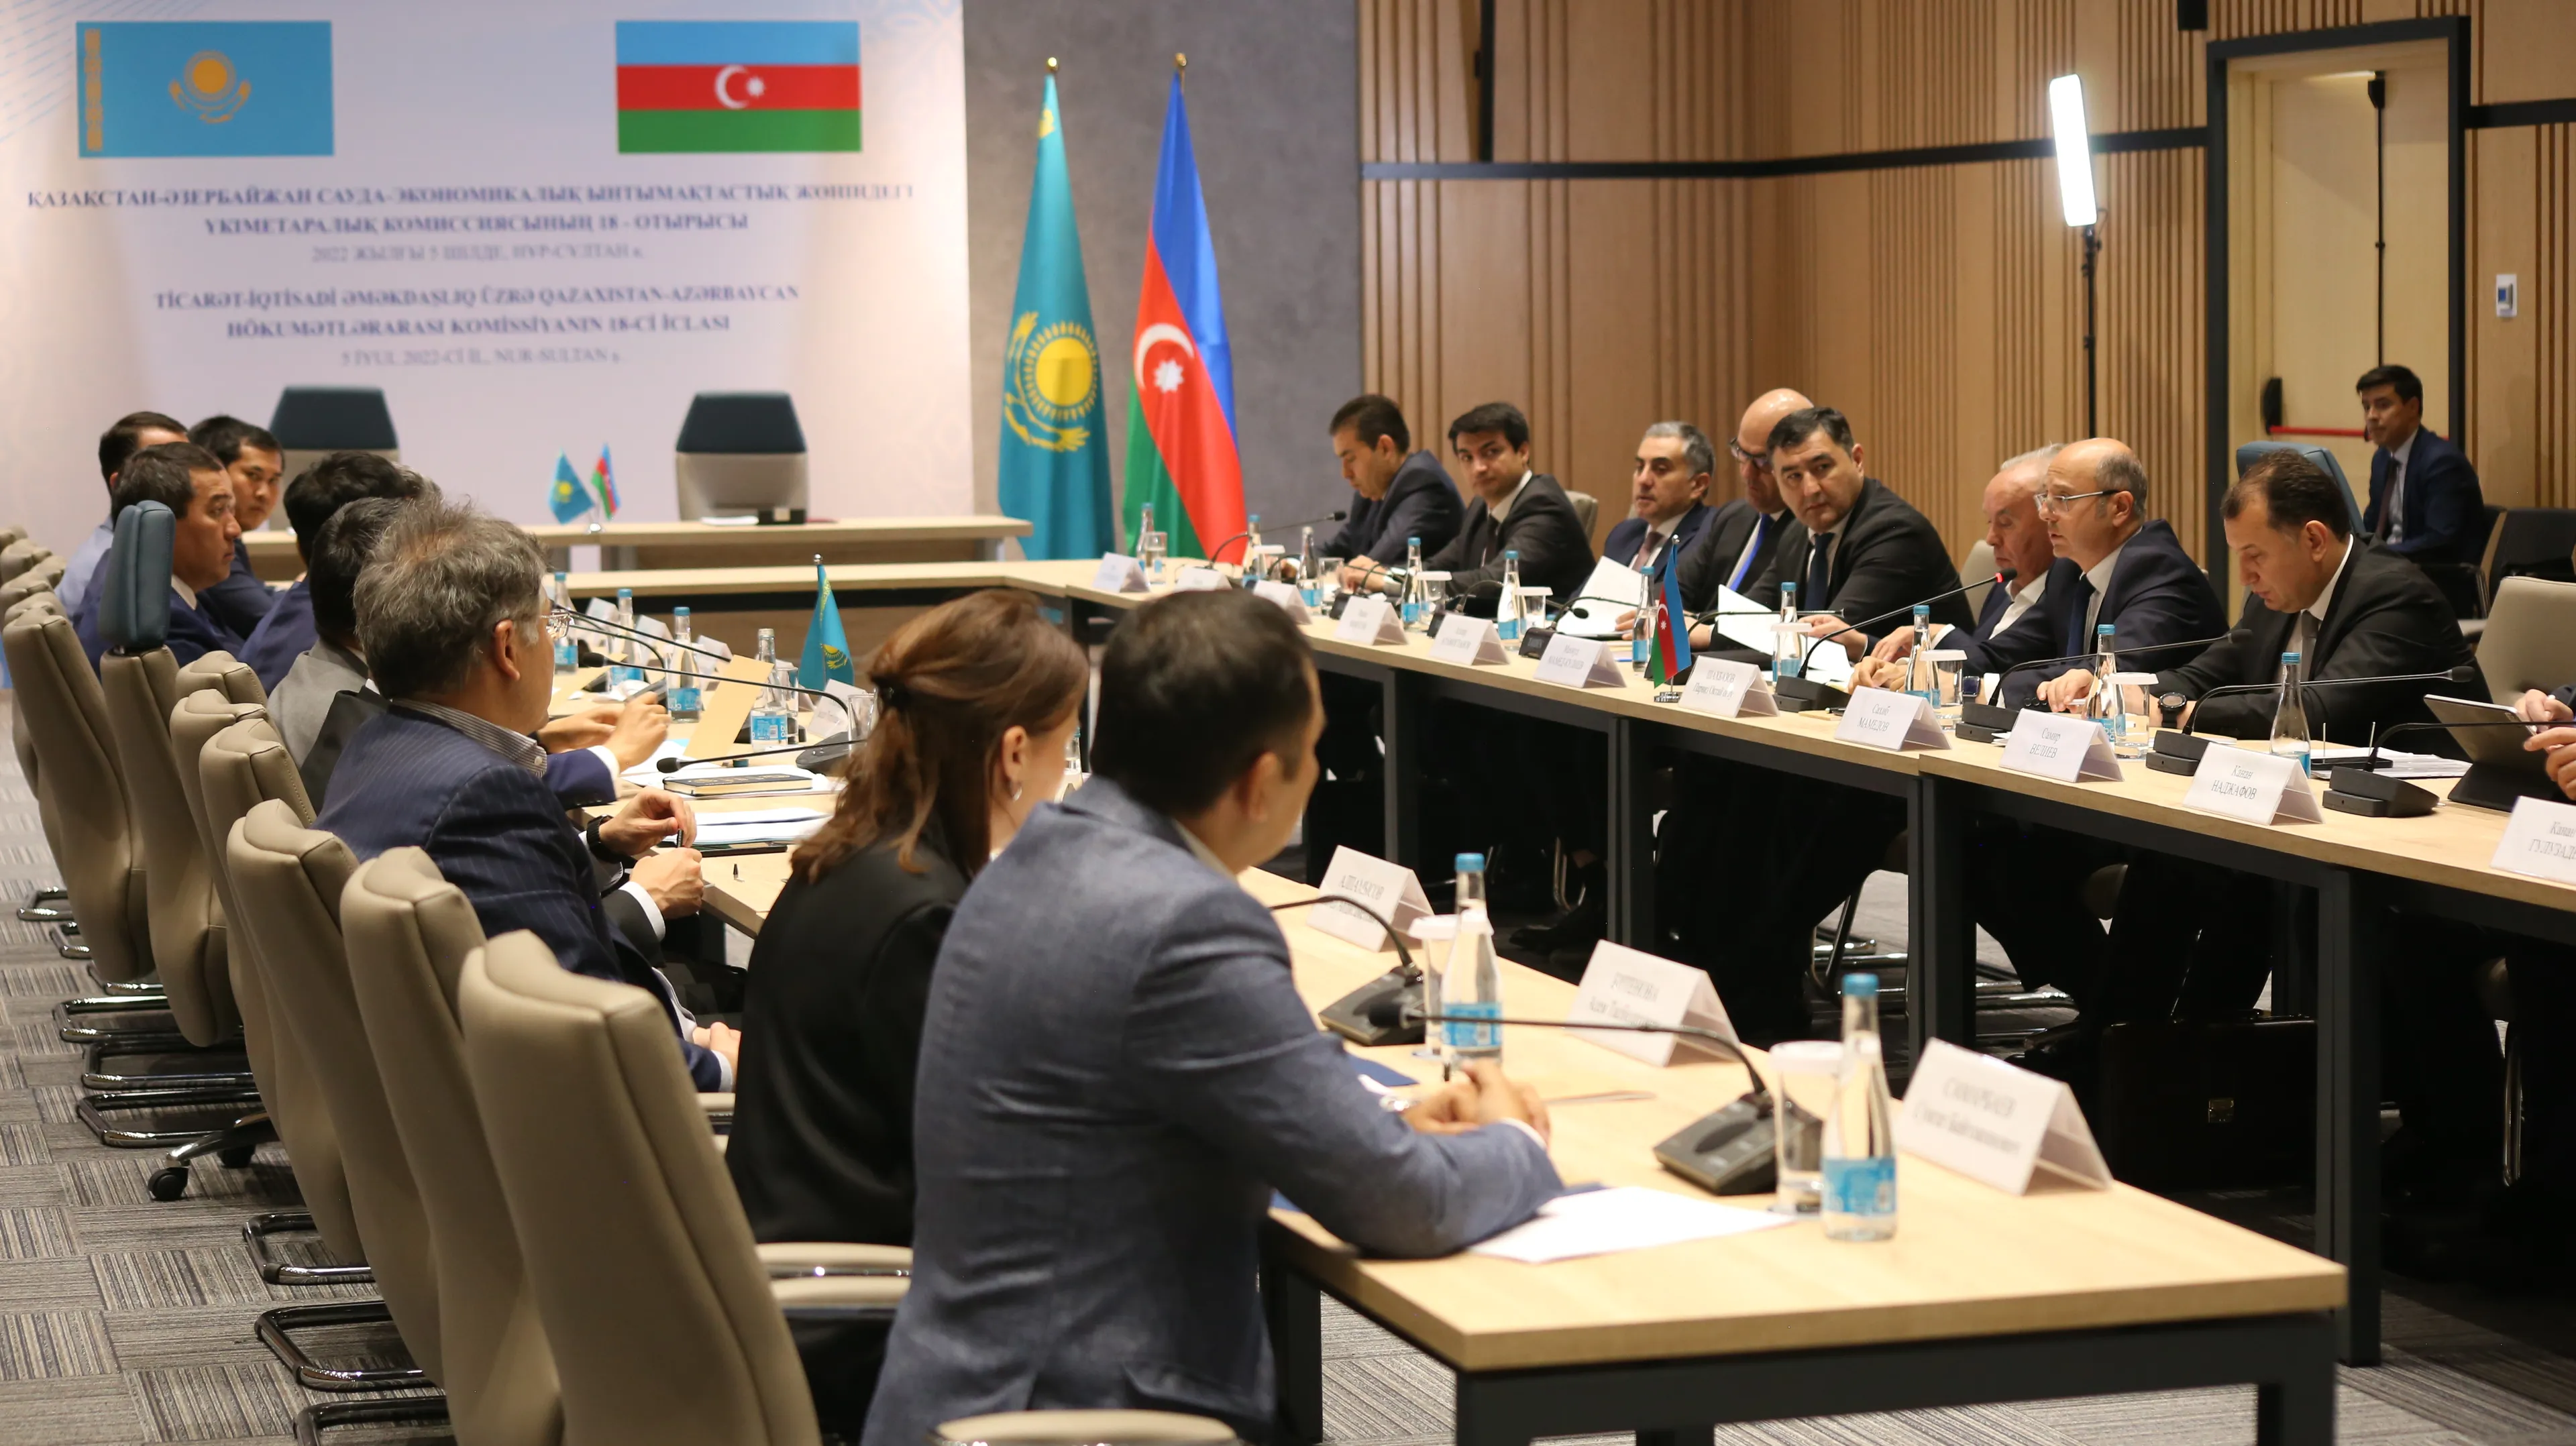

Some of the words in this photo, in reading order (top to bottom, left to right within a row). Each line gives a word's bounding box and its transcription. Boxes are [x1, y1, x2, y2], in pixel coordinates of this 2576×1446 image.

[599, 215, 619, 231] 18
[311, 246, 349, 262] 2022
[1858, 717, 1890, 732] МАМЕДОВ
[2041, 728, 2061, 744] Самир
[2029, 743, 2058, 759] ВЕЛИЕВ
[2231, 765, 2253, 779] Канан
[2211, 779, 2257, 799] НАДЖАФОВ
